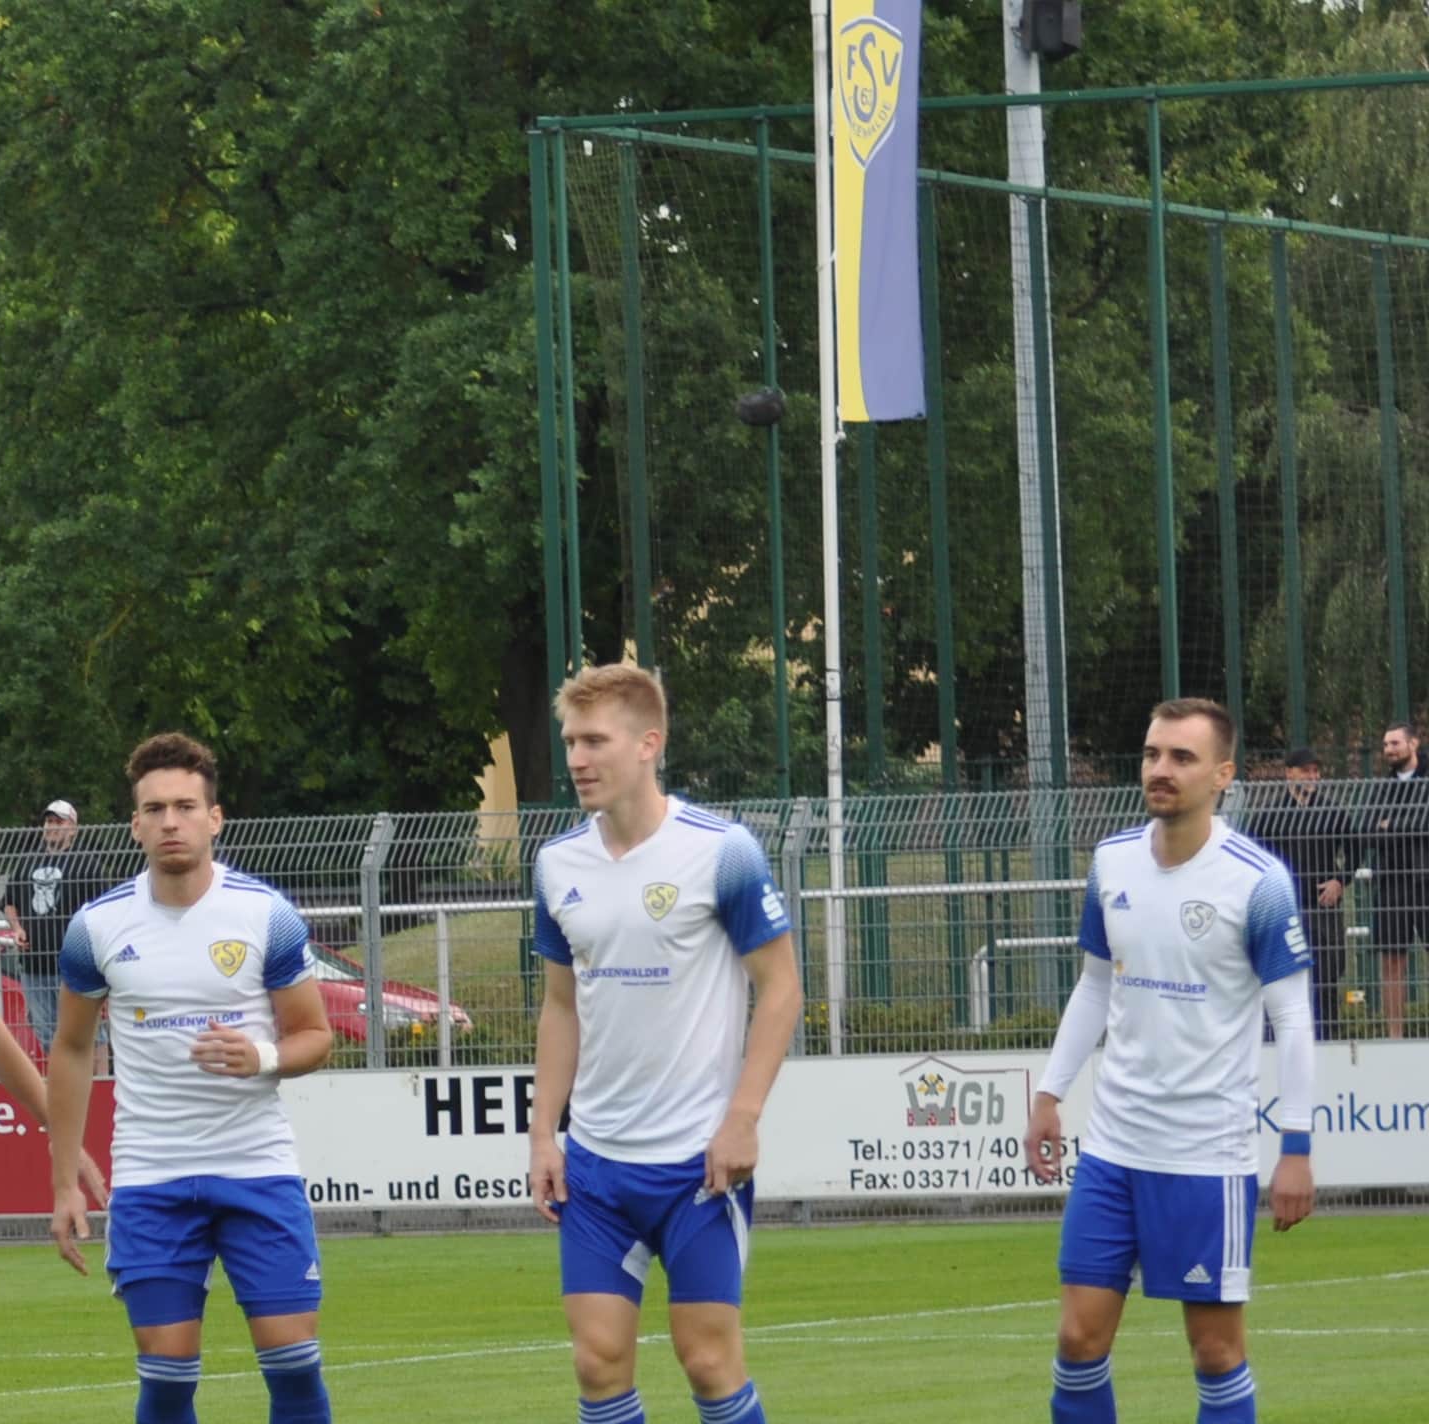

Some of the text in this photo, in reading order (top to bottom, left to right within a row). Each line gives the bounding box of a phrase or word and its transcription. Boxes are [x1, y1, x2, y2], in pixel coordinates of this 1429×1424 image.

[847, 32, 899, 122] FSV
[1123, 976, 1206, 994] LUCKENWALDER
[146, 1011, 245, 1029] LUCKENWALDER
[1256, 1092, 1429, 1134] Knikum
[849, 1139, 898, 1161] Tel.:
[303, 1176, 374, 1202] ohn-
[388, 1175, 440, 1200] und
[850, 1168, 898, 1190] Fax:
